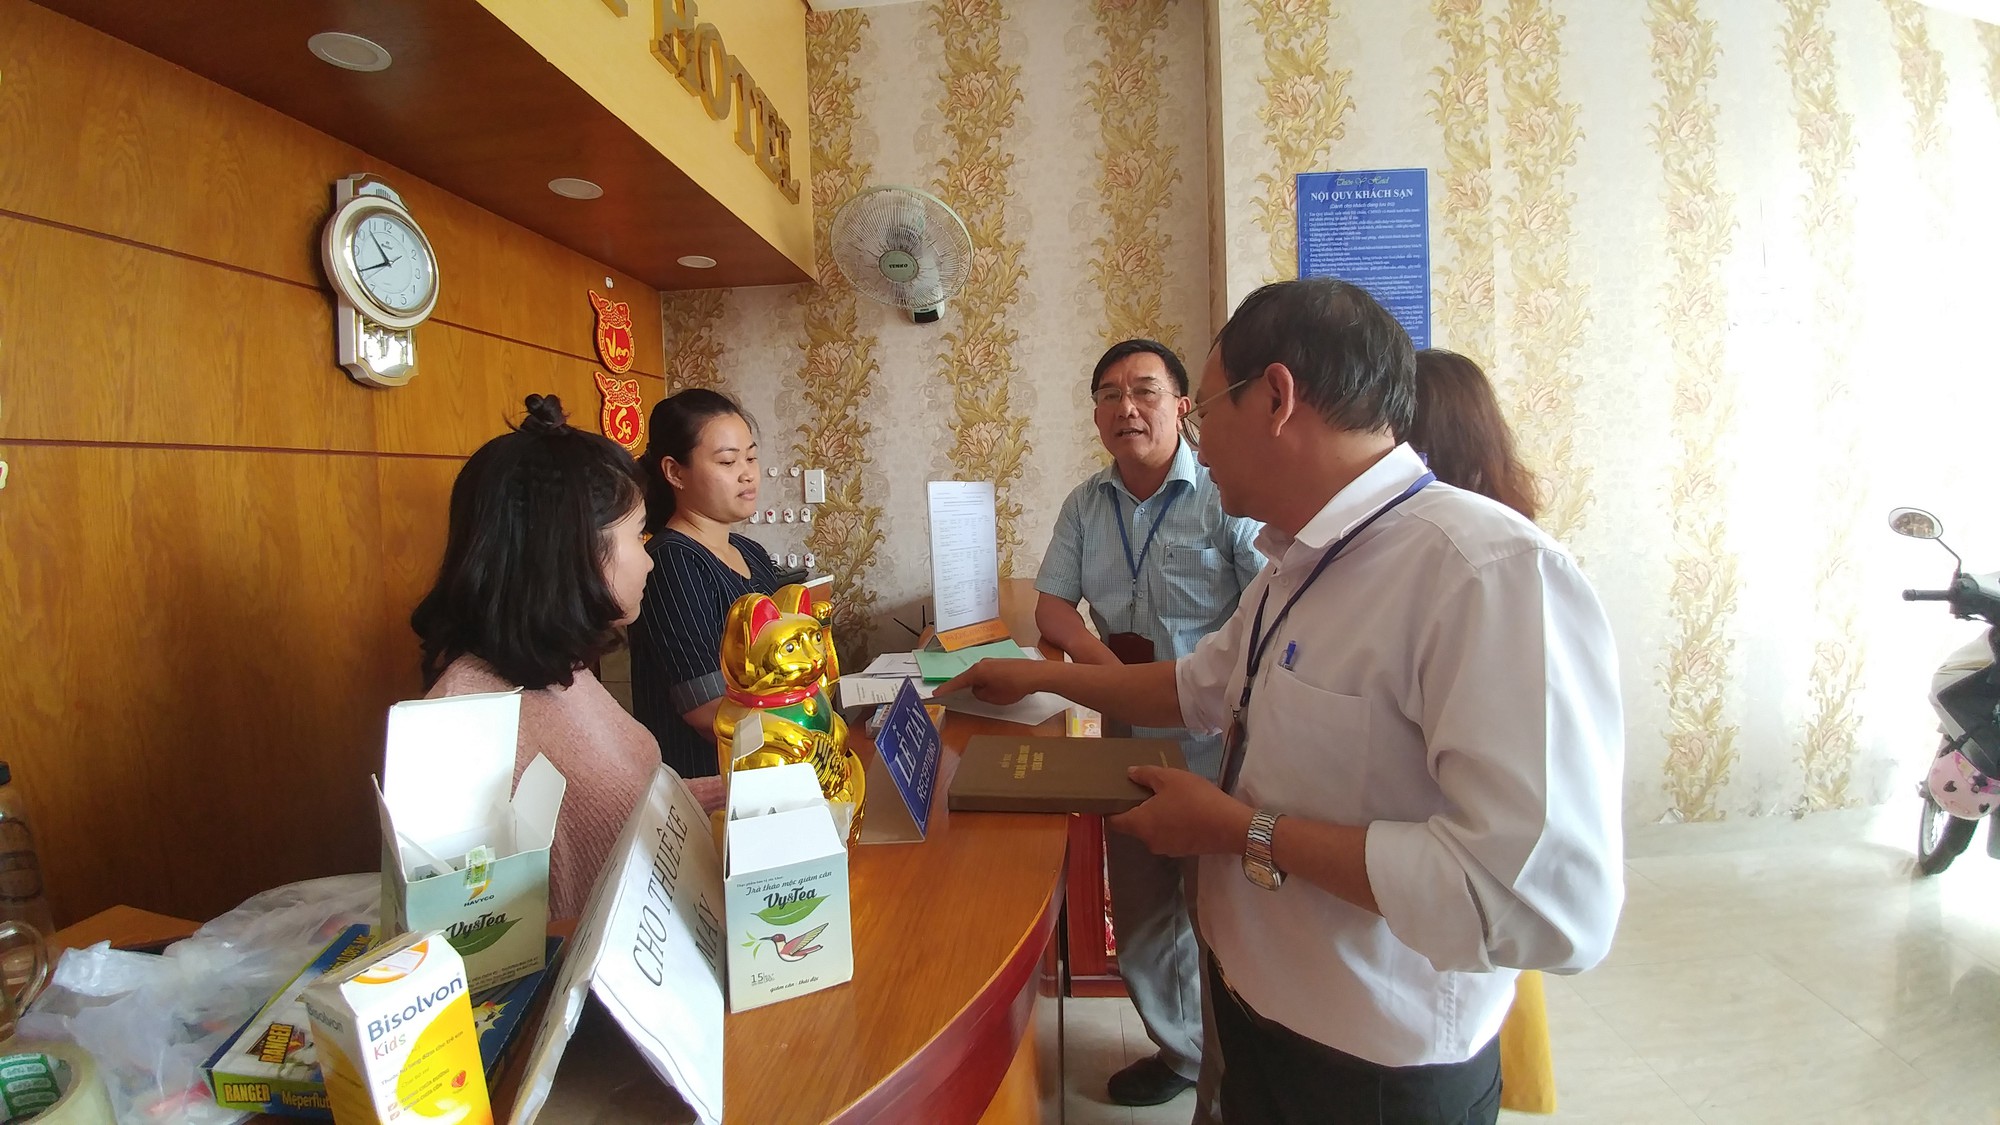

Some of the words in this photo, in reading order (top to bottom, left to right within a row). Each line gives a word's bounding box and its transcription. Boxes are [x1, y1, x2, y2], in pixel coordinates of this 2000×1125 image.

[650, 0, 800, 204] HOTEL
[1311, 191, 1329, 202] NỘI
[1331, 191, 1355, 201] QUY
[1355, 187, 1391, 199] KHÁCH
[1393, 188, 1414, 199] SẠN
[892, 723, 917, 788] LỄ
[905, 701, 928, 752] TÂN
[916, 738, 937, 804] RECEPTIONS
[666, 805, 688, 849] XE
[647, 827, 681, 915] THUÊ
[745, 886, 761, 896] Trà
[464, 894, 495, 907] HAVYCO
[633, 905, 667, 987] CHO
[693, 892, 720, 971] MÁY
[751, 973, 763, 983] 15
[306, 1001, 345, 1033] Bisolvon
[368, 977, 463, 1042] Bisolvon
[258, 1023, 294, 1064] RANGER
[373, 1033, 407, 1060] Kids
[224, 1083, 271, 1103] RANGER
[282, 1091, 332, 1110] Meperflut
